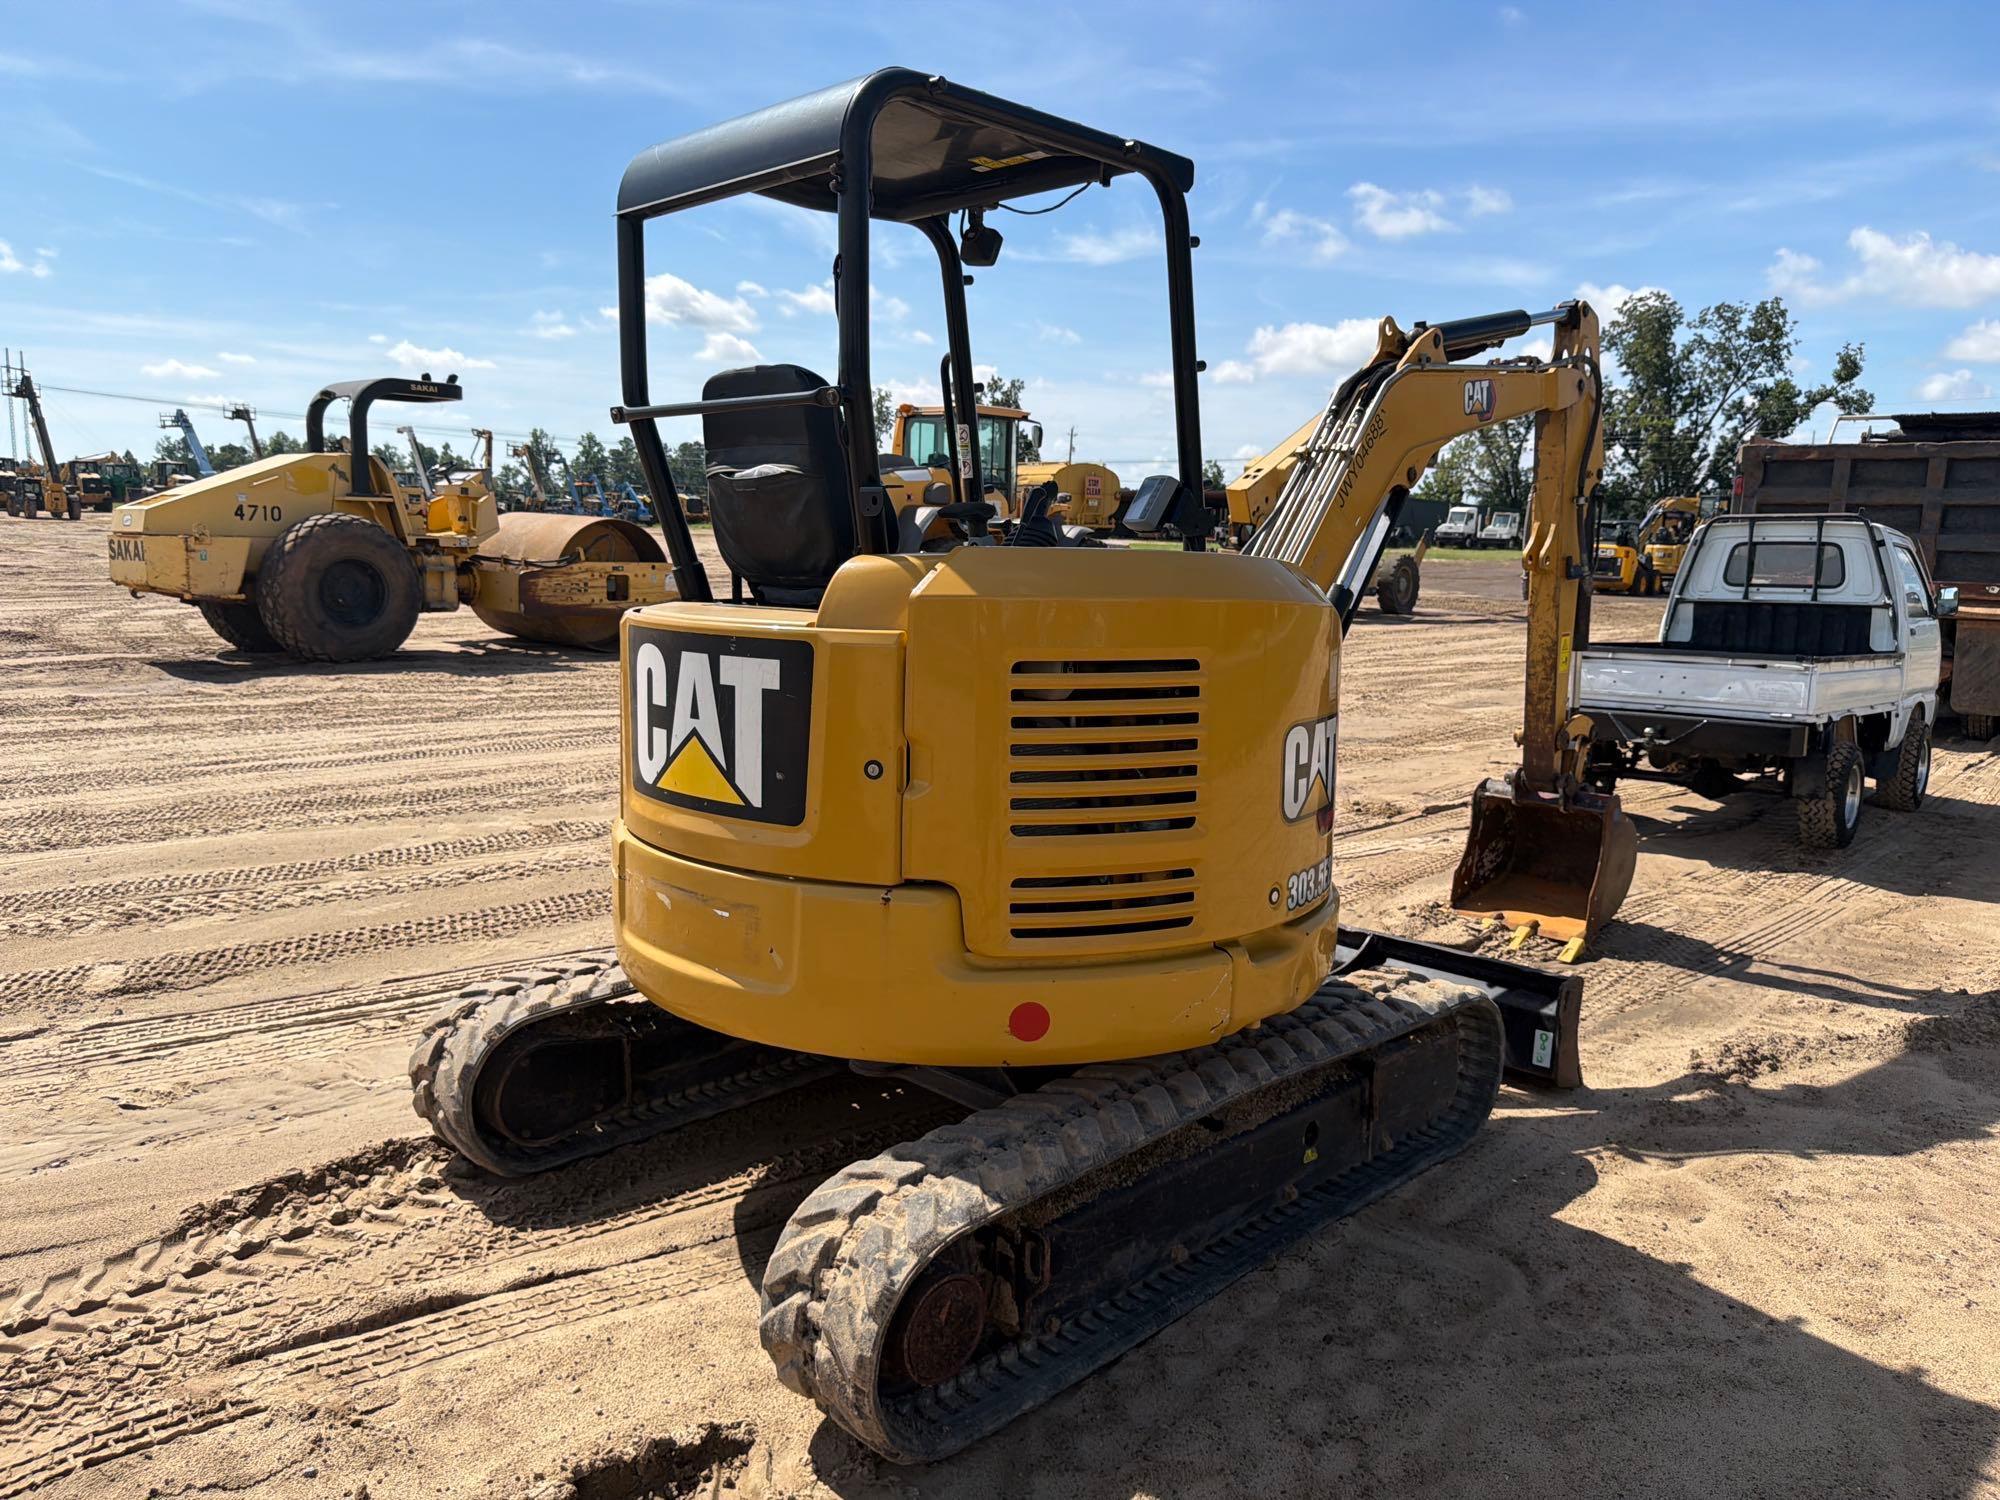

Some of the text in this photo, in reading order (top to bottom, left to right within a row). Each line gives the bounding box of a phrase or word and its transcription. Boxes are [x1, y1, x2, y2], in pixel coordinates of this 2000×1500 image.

[410, 384, 438, 393] SAKAI
[1464, 380, 1490, 415] CAT
[1337, 413, 1385, 509] JWY04688
[1086, 487, 1101, 496] CLEAR
[233, 503, 283, 522] 4710
[108, 539, 145, 562] SAKAI
[636, 642, 781, 809] CAT
[1283, 716, 1337, 819] CAT
